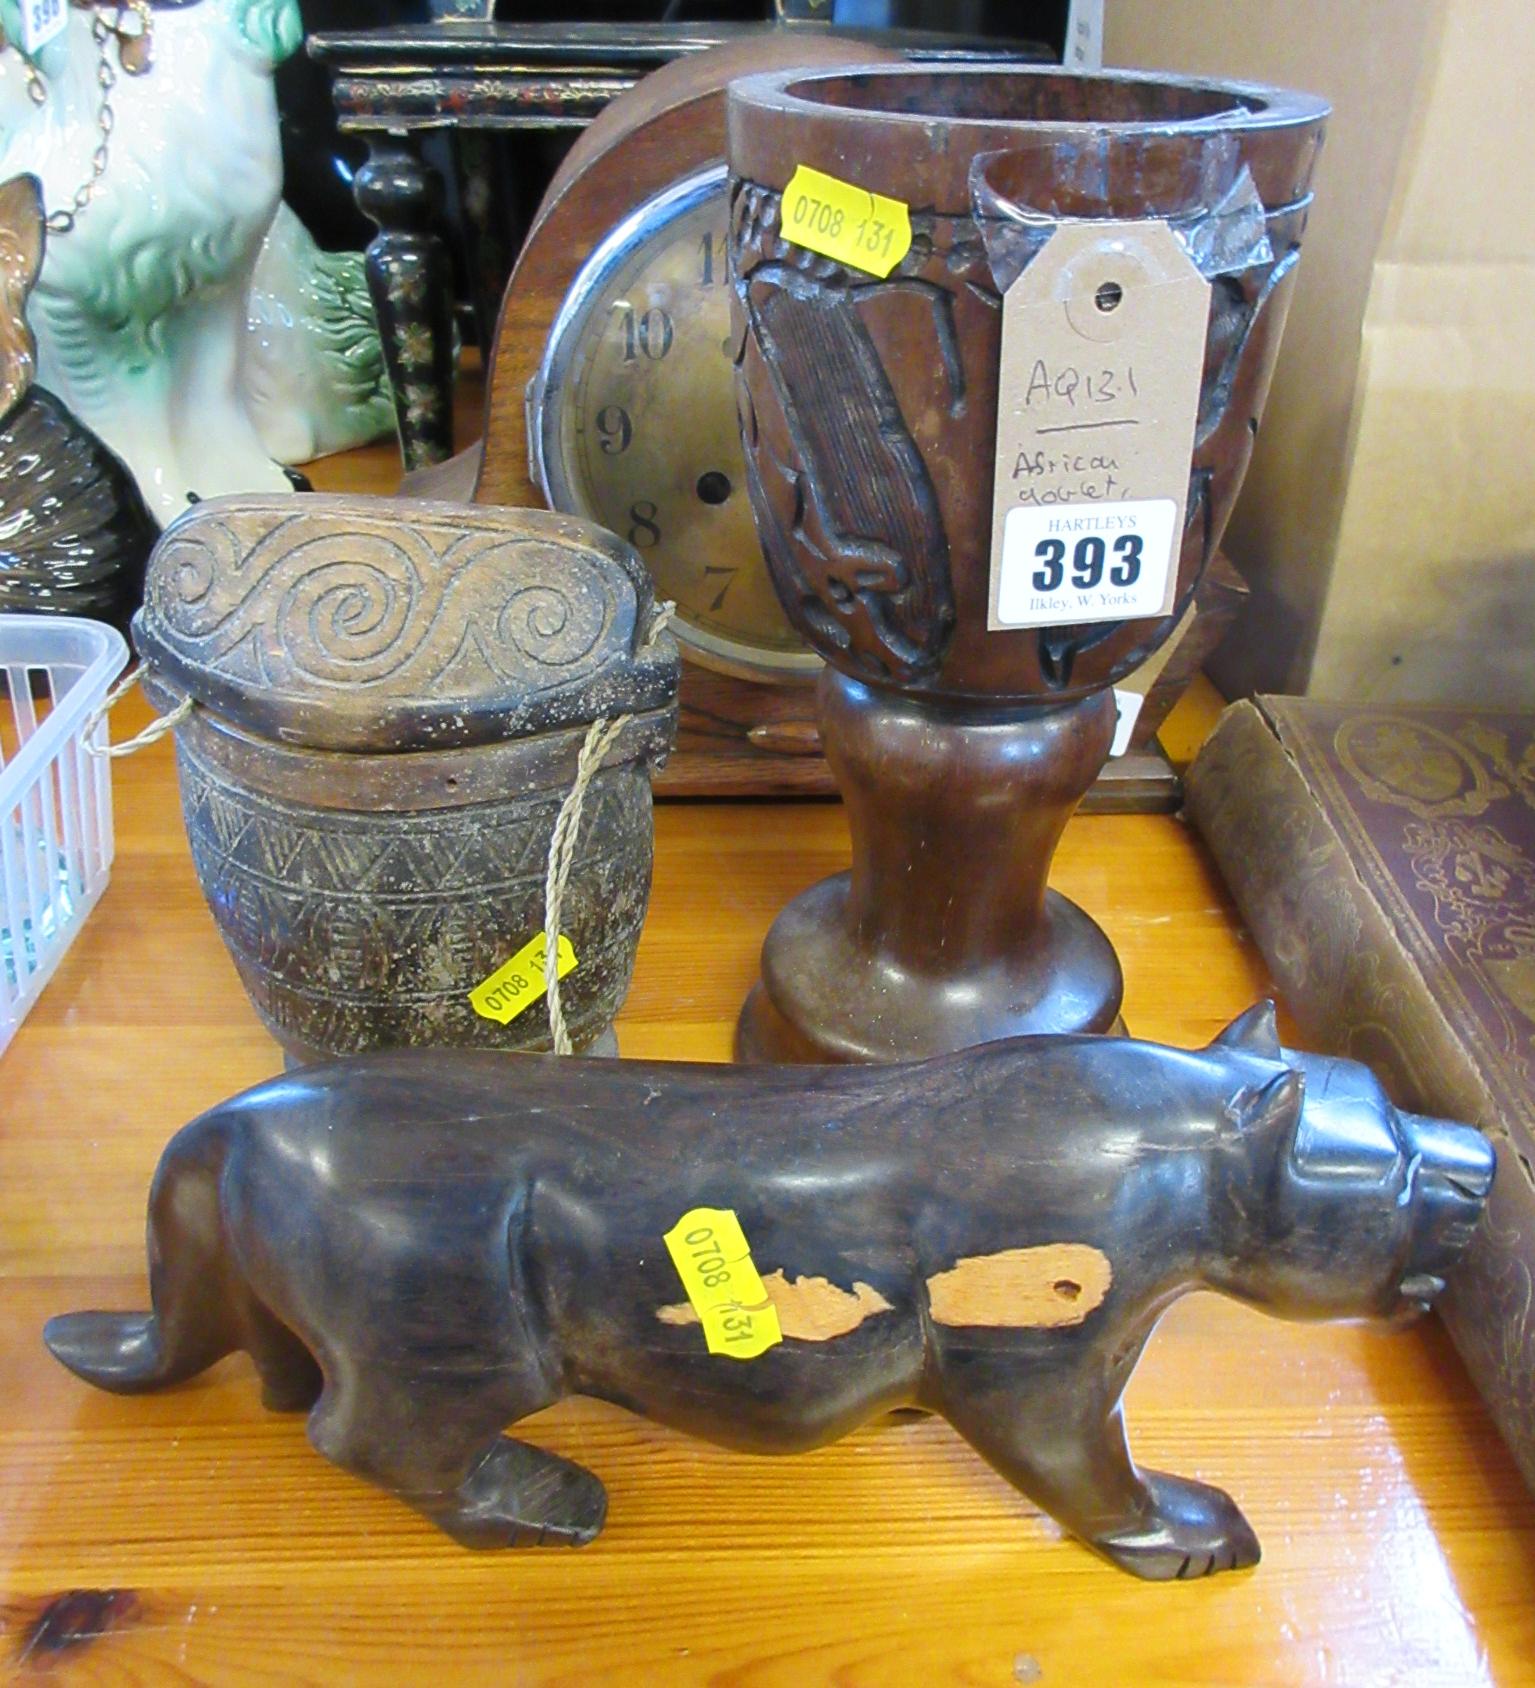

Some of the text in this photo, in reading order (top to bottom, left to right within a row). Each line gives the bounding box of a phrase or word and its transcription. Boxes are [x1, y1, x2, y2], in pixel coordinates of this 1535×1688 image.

[793, 194, 895, 259] 0708 131
[617, 308, 674, 362] 10
[596, 404, 632, 455] 9
[628, 501, 661, 548] 8
[1048, 514, 1137, 533] HARTLEYS
[1032, 534, 1144, 592] 393
[705, 565, 739, 612] 7
[1077, 595, 1096, 608] W.
[1099, 592, 1137, 605] Yorks
[484, 974, 529, 1011] 0708
[684, 1227, 755, 1343] 0708 131
